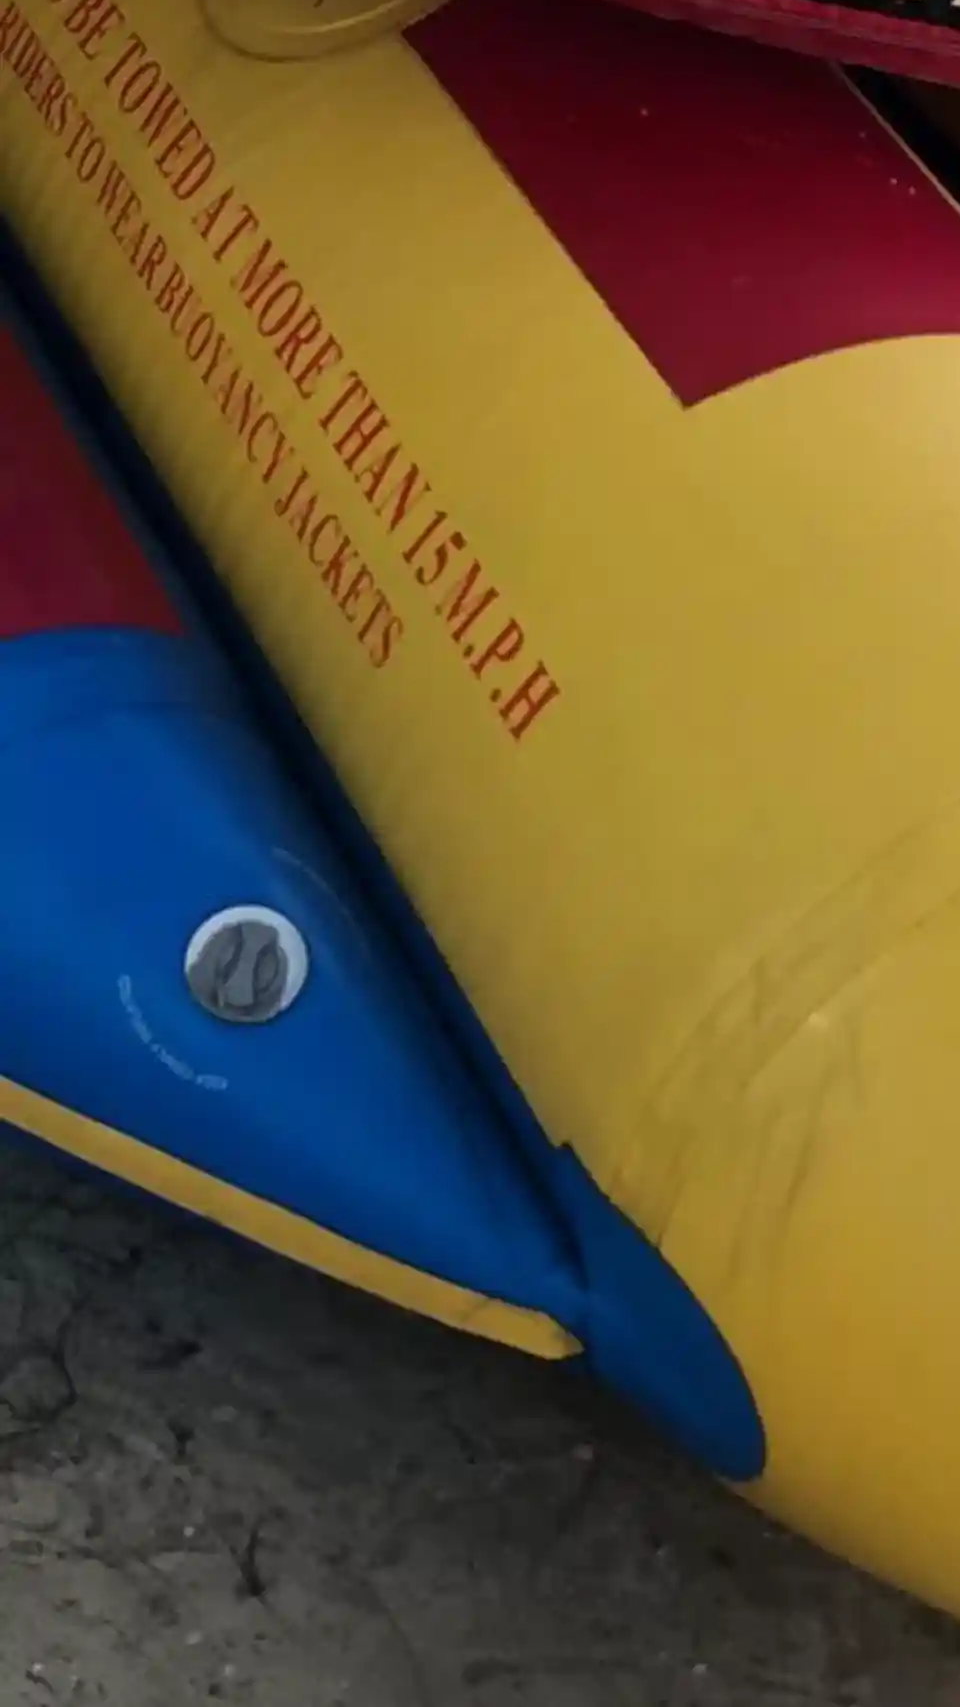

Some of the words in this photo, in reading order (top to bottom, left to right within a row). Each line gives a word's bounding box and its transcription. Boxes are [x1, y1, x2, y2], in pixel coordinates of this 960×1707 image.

[103, 32, 217, 200] TOWED
[190, 185, 260, 263] AT
[0, 0, 79, 137] RIDERS
[64, 111, 106, 184] TO
[97, 159, 168, 291] WEAR
[154, 260, 297, 484] BUOYANCY
[273, 466, 406, 669] JACKETS
[230, 238, 345, 400] MORE
[318, 369, 433, 535] THAN
[401, 509, 468, 587] 15
[433, 557, 562, 743] M.P.H
